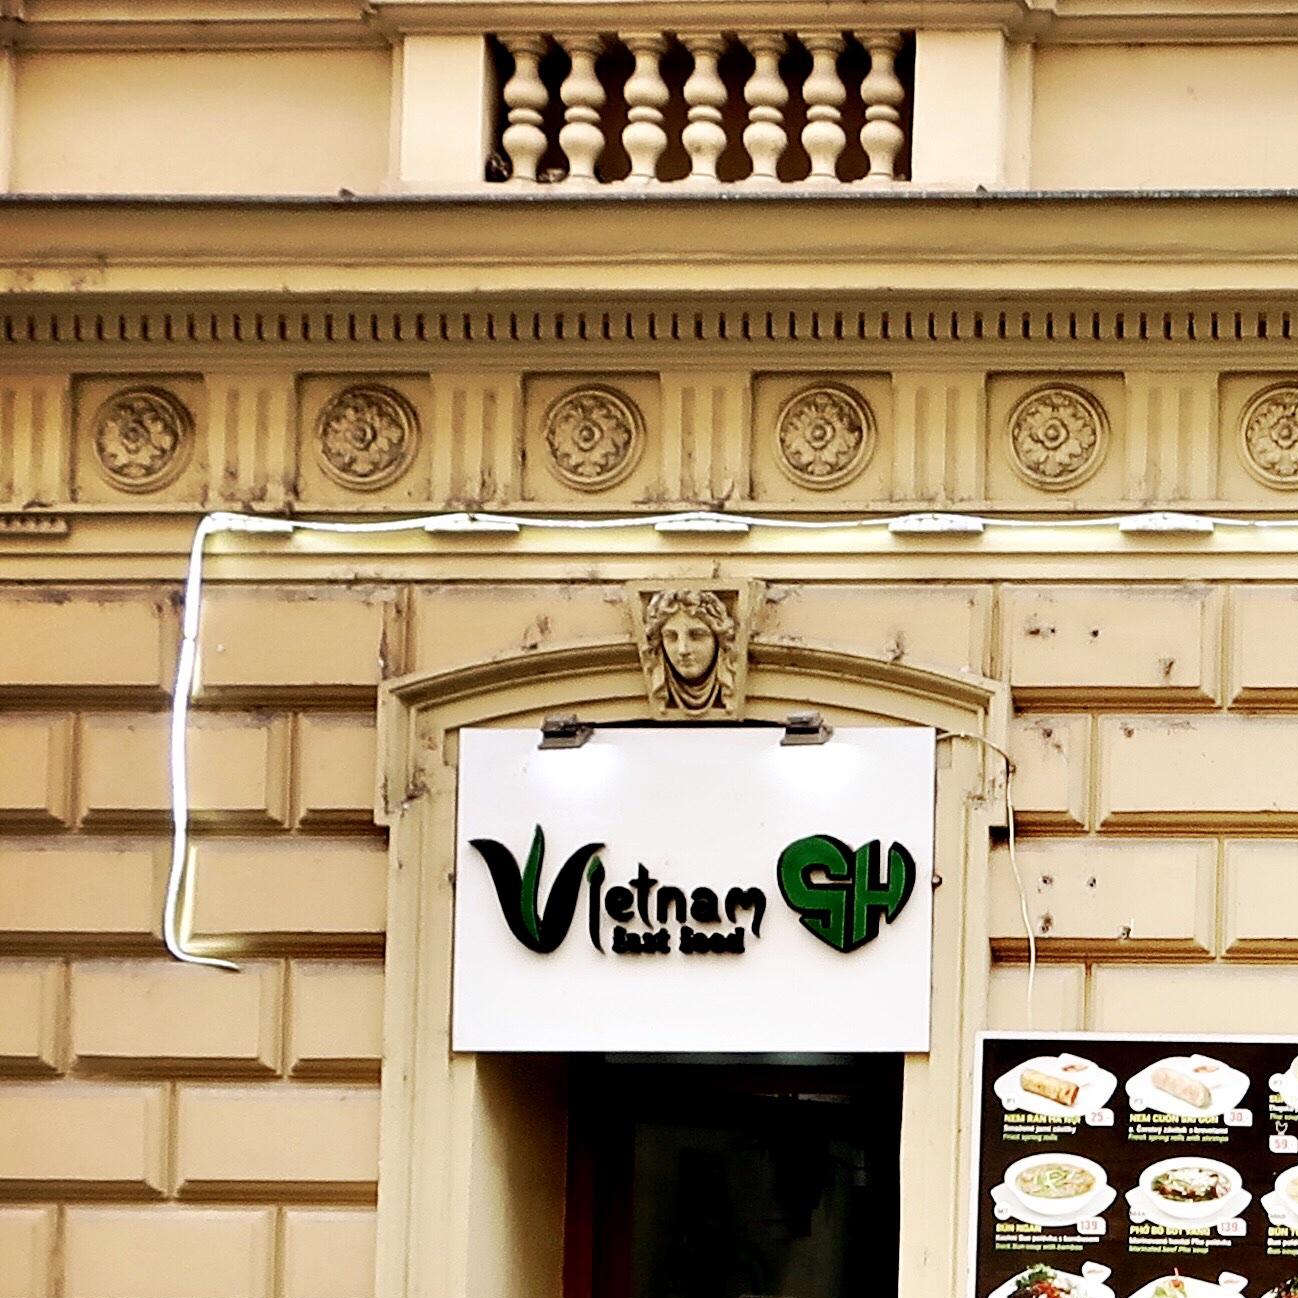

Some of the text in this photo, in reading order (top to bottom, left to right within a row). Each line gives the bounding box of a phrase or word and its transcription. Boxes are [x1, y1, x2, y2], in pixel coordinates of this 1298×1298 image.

[469, 824, 766, 954] Vietnam
[612, 926, 745, 953] fast food
